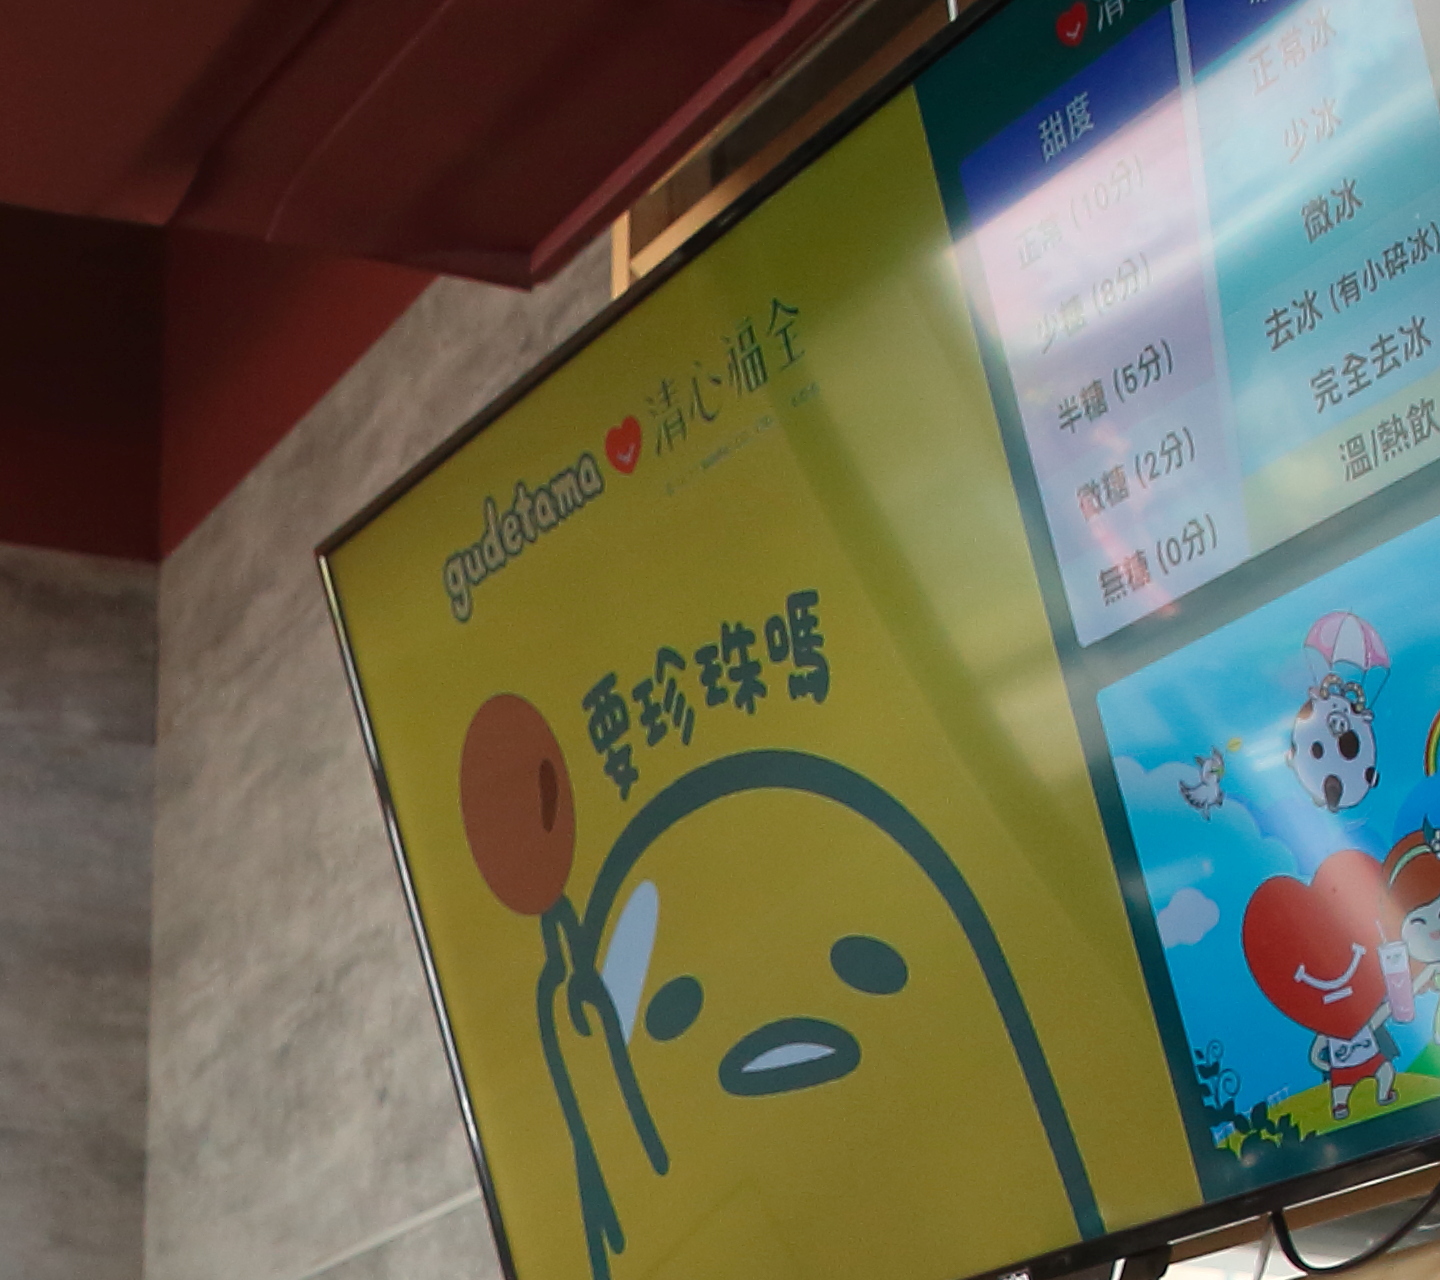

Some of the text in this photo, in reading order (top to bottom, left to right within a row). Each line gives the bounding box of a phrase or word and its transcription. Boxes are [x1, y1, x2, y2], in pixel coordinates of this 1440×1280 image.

[1248, 7, 1336, 96] 正常冰
[1037, 91, 1096, 164] 甜度
[1284, 99, 1342, 164] 少冰
[1301, 178, 1363, 244] 微冰
[1265, 289, 1324, 353] 去冰
[1309, 315, 1432, 414] 完全去冰
[646, 297, 805, 457] 清心福全
[1057, 339, 1174, 434] 半糖 (5分)
[1076, 426, 1195, 521] 微糖 (2分)
[443, 451, 606, 623] gudetama
[1096, 513, 1219, 606] 無糖 (0分)
[581, 586, 832, 802] 要珍珠嗎
